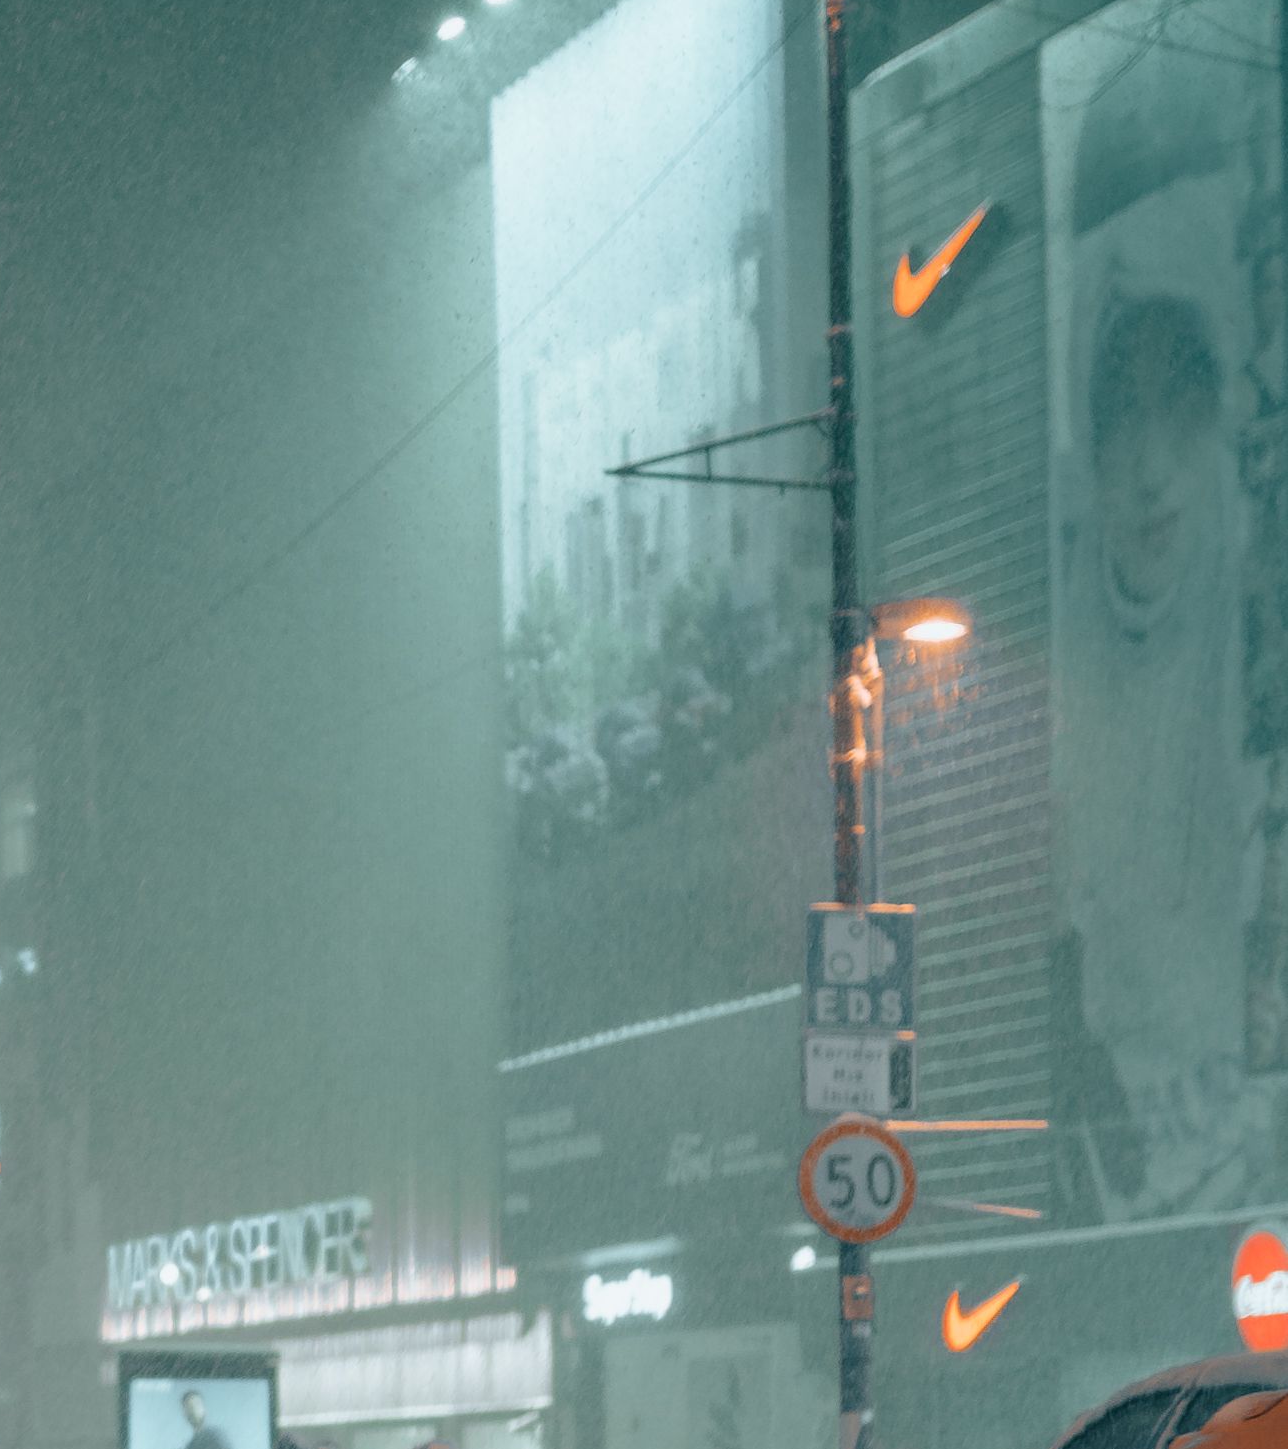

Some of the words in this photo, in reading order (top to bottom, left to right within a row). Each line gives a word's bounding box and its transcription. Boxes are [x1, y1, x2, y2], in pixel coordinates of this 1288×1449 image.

[815, 987, 903, 1024] EDS
[827, 1152, 896, 1211] 50
[106, 1229, 197, 1310] MARKS
